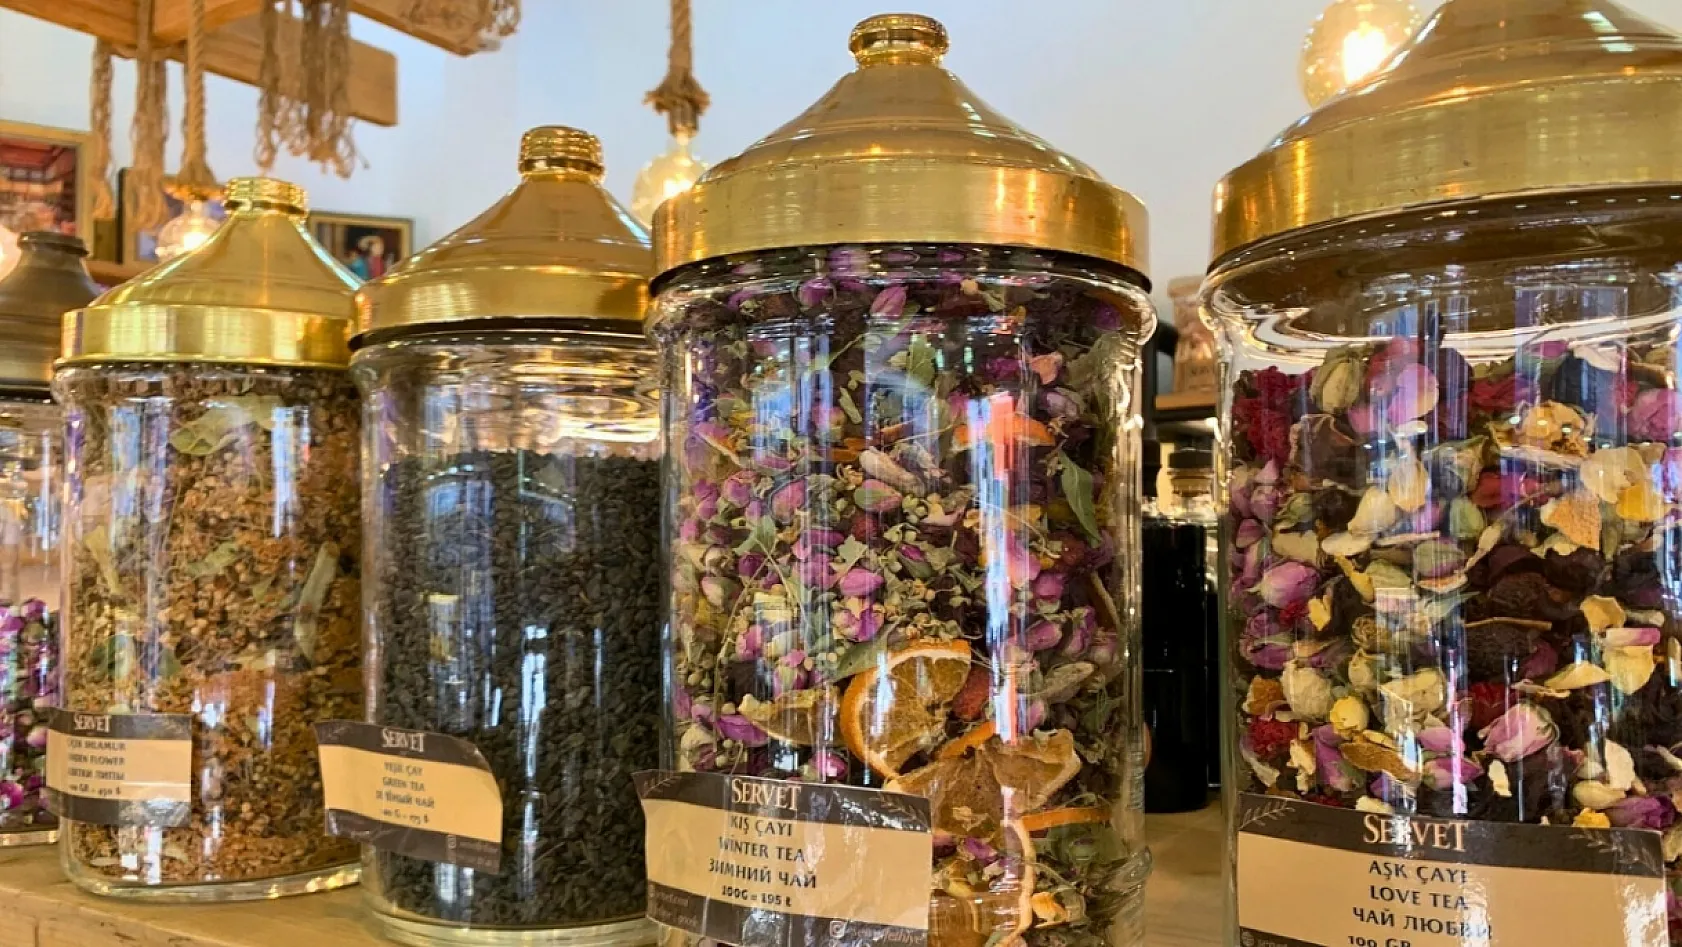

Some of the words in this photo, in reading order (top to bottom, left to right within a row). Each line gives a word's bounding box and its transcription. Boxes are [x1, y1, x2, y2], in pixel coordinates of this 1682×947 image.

[382, 728, 425, 752] SERVET
[382, 776, 407, 788] GREEN
[410, 780, 425, 792] TEA
[731, 778, 802, 811] SERVET
[731, 815, 749, 834] KIŞ
[755, 819, 793, 837] ÇAYI
[776, 846, 805, 863] TEA
[708, 858, 771, 884] ЗИМНИЙ
[778, 870, 816, 889] ЧАЙ
[1369, 860, 1408, 880] AŞK
[1416, 866, 1468, 885] ÇAYI
[722, 884, 748, 900] 100G
[761, 892, 782, 904] 195
[1370, 885, 1421, 905] LOVE
[1429, 892, 1469, 911] TEA
[1352, 907, 1395, 928] ЧАЙ
[1403, 915, 1493, 940] ЛЮБВИ
